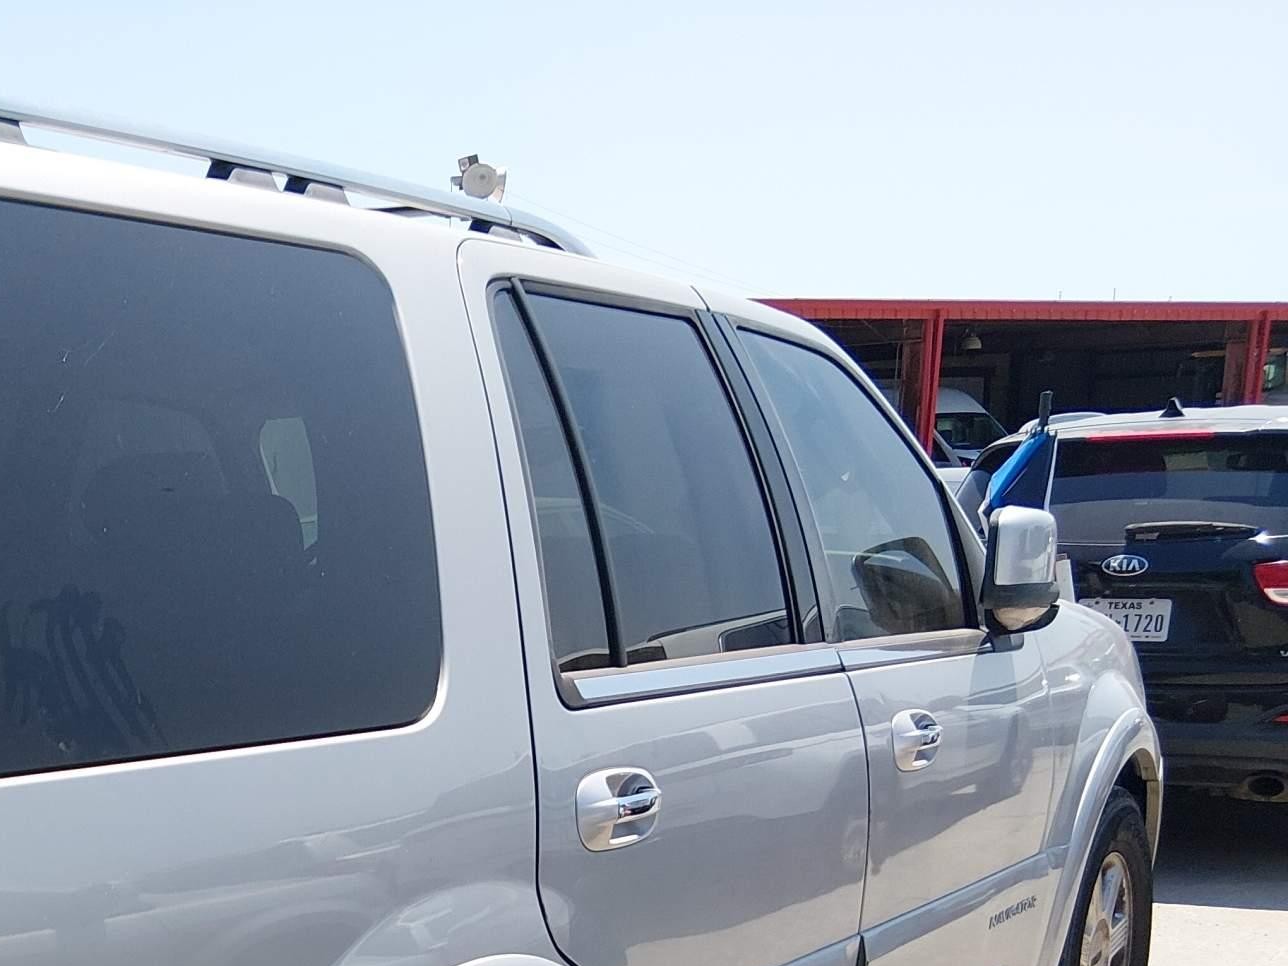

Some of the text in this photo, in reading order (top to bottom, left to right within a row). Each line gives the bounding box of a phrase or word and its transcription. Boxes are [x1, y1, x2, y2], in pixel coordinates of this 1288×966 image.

[1109, 558, 1141, 572] KIA
[1108, 601, 1143, 610] TEXAS
[1105, 613, 1165, 633] 1720
